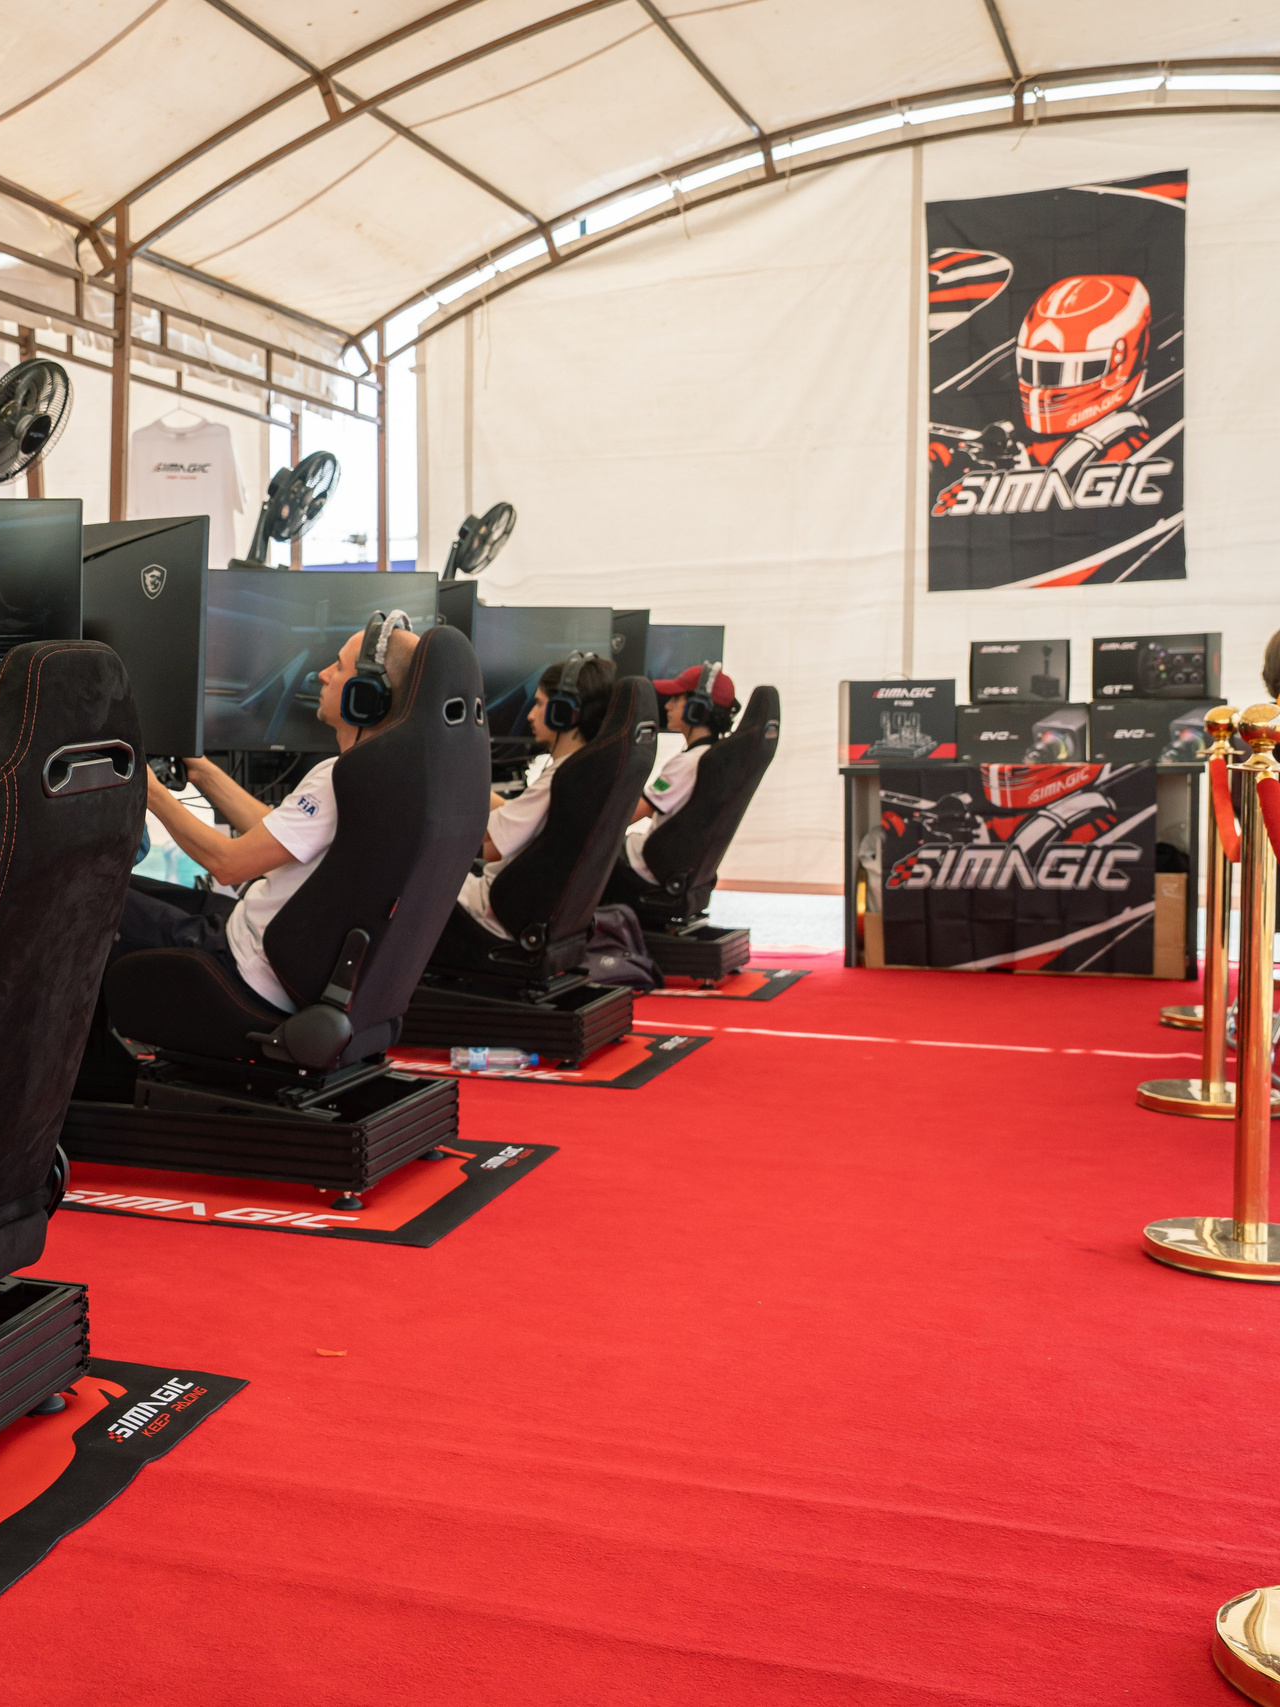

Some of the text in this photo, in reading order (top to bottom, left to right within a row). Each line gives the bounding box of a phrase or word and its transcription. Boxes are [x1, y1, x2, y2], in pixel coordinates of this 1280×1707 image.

[936, 458, 1173, 516] SIMAGIC
[1029, 767, 1090, 803] SIMAGIC
[892, 844, 1141, 889] SIMAGIC
[63, 1190, 360, 1228] SIMAGIC
[107, 1377, 194, 1439] SIMAGIC
[141, 1386, 208, 1438] KEEP RACING
